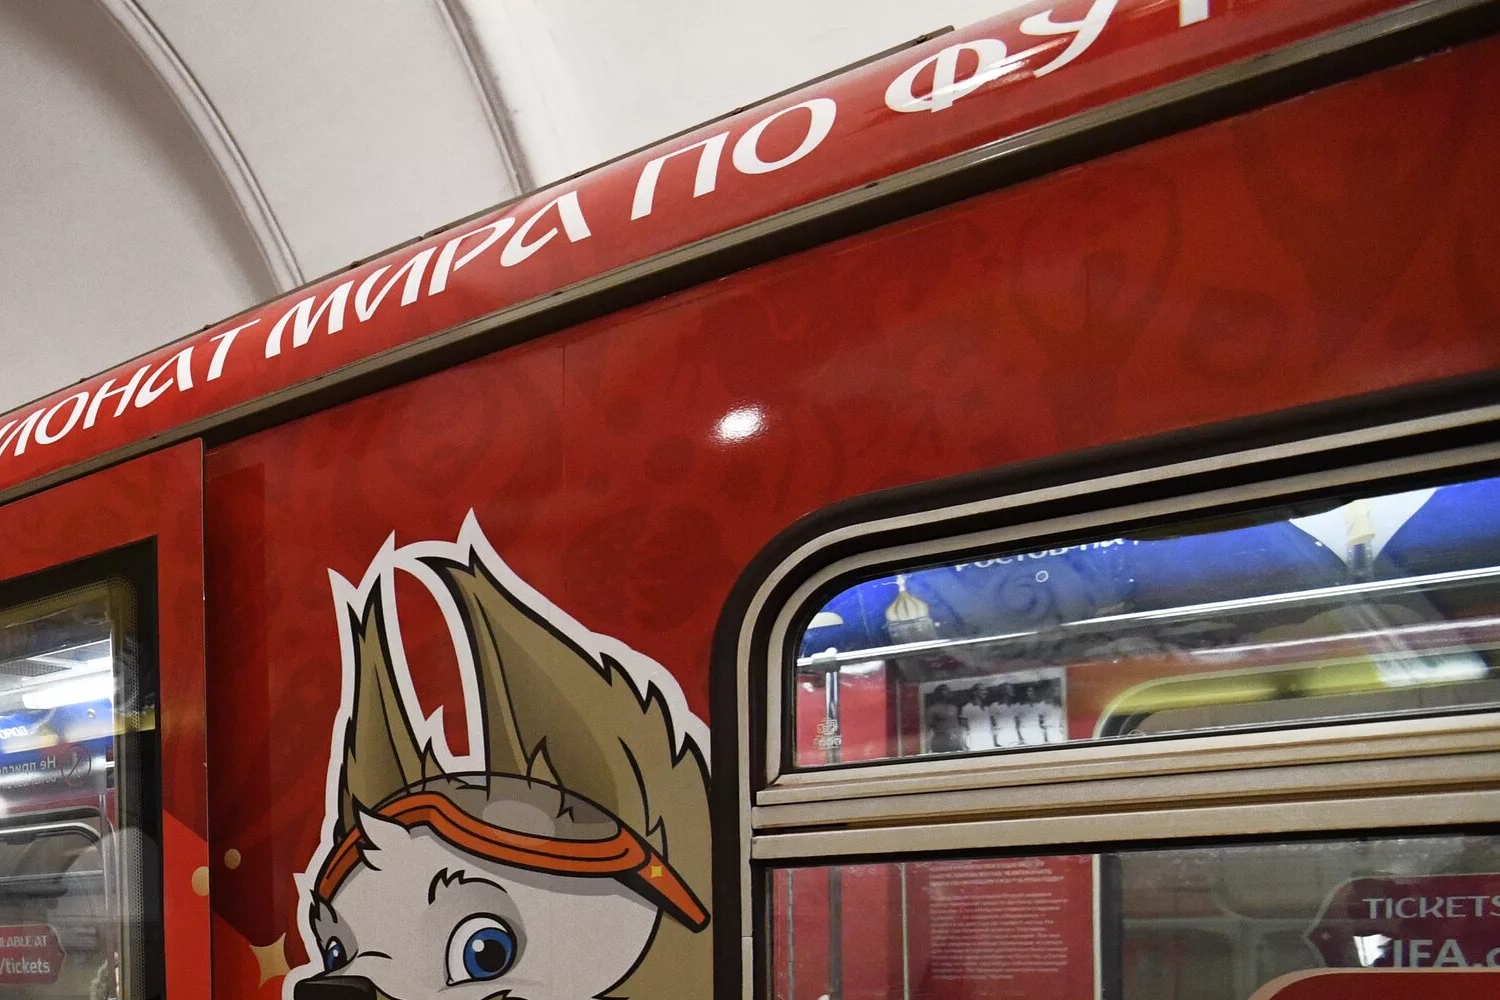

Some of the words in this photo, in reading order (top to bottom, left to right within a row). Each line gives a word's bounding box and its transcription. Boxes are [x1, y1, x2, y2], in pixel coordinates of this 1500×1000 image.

[265, 191, 592, 359] МИРА
[630, 98, 836, 221] ПО
[884, 0, 1209, 113] ФУ
[34, 935, 48, 948] AT
